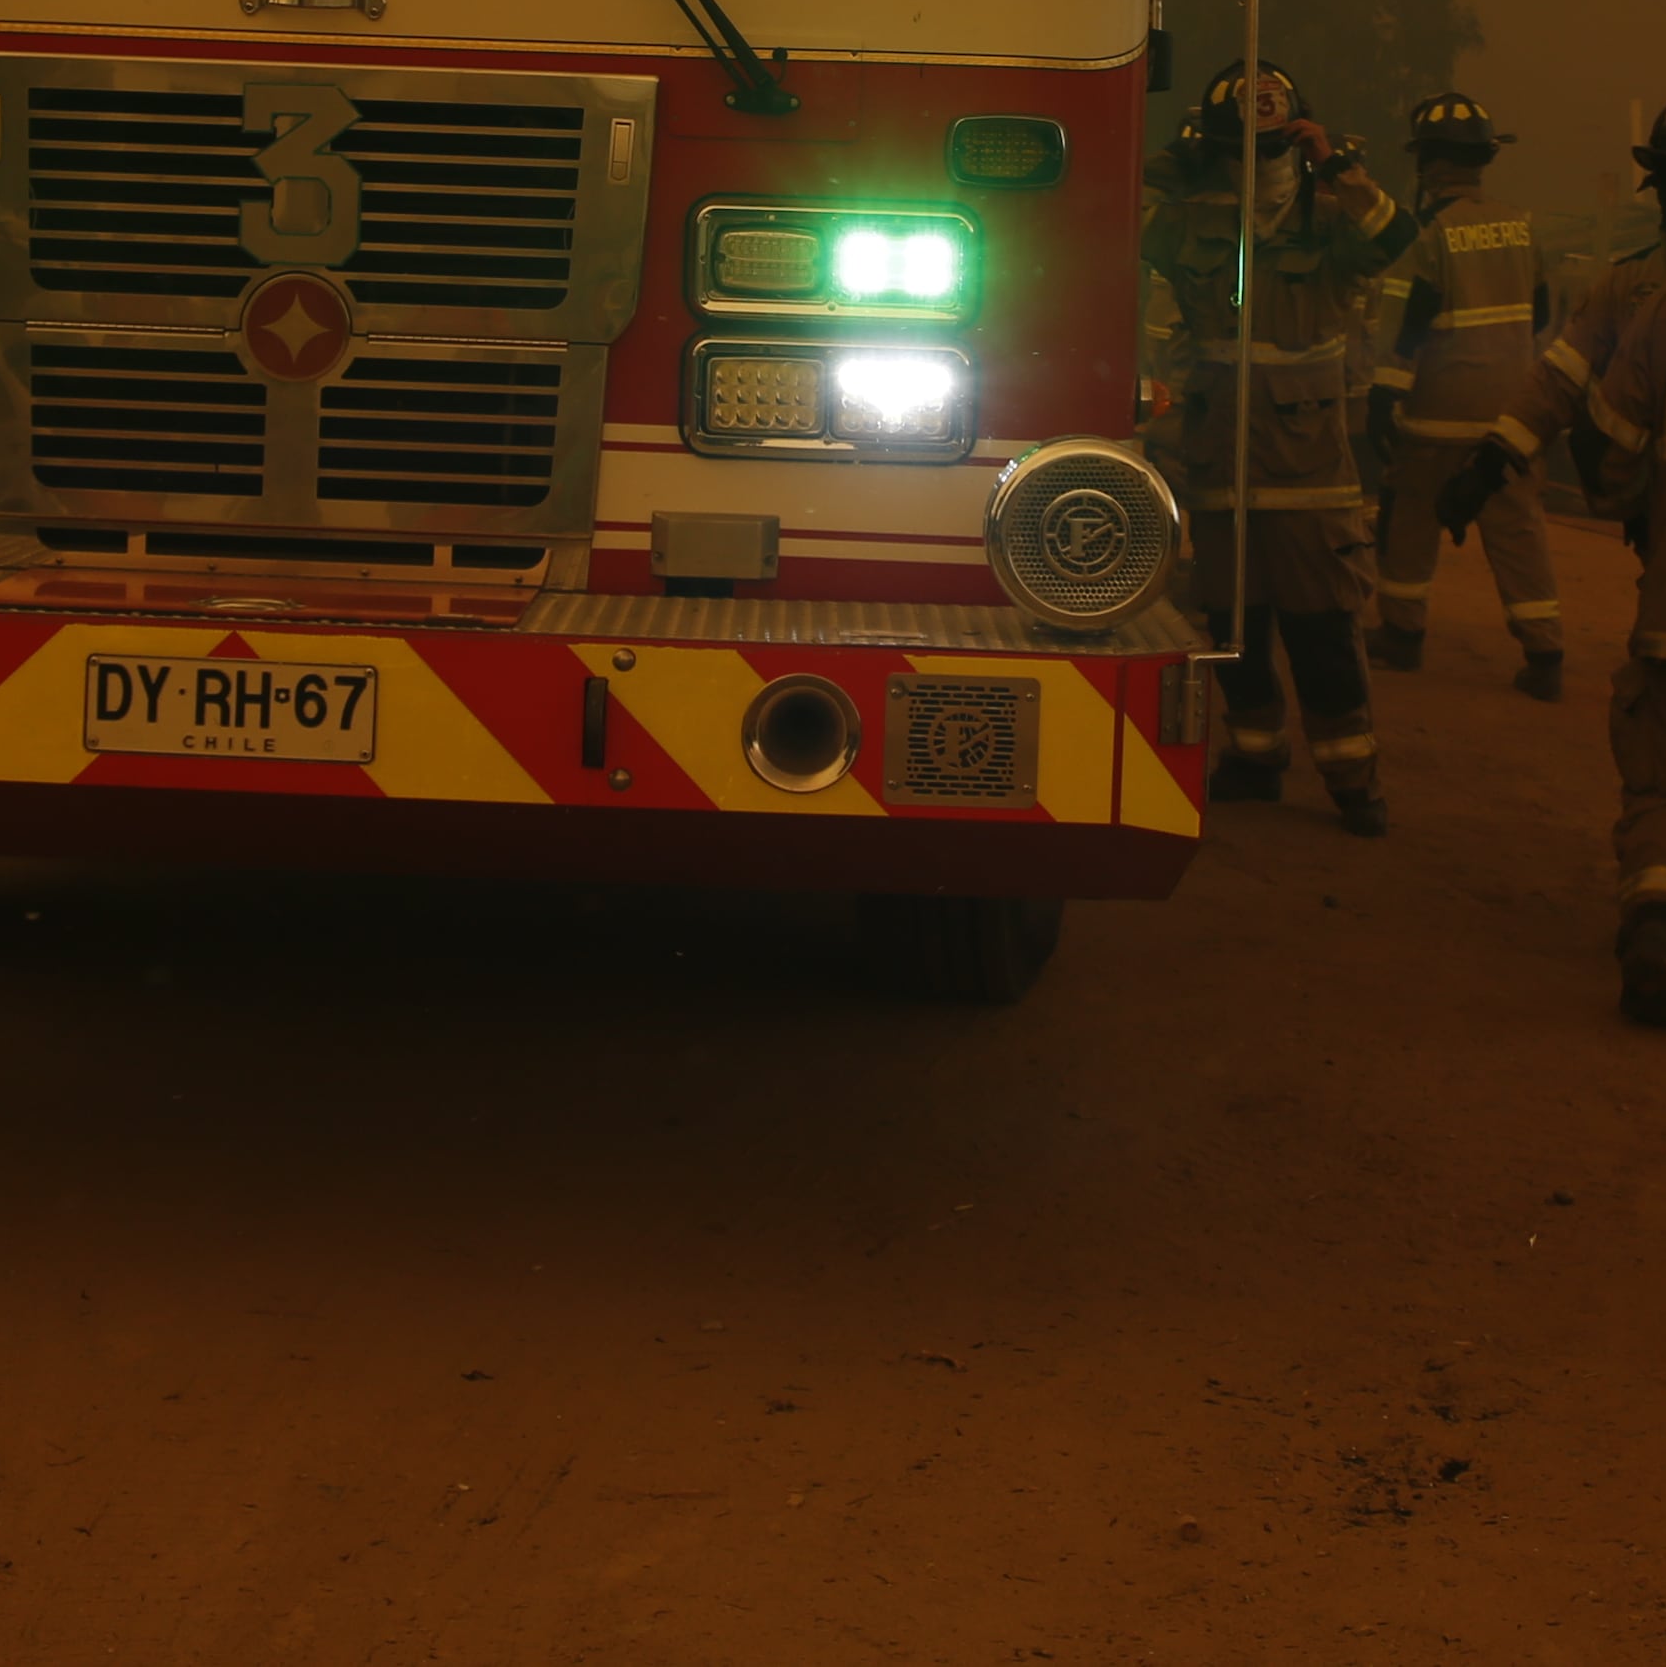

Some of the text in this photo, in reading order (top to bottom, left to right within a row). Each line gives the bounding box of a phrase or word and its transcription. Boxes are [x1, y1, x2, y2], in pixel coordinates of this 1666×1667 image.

[238, 82, 363, 265] 3
[1445, 220, 1530, 254] BOMBEROS
[183, 735, 276, 753] CHILE
